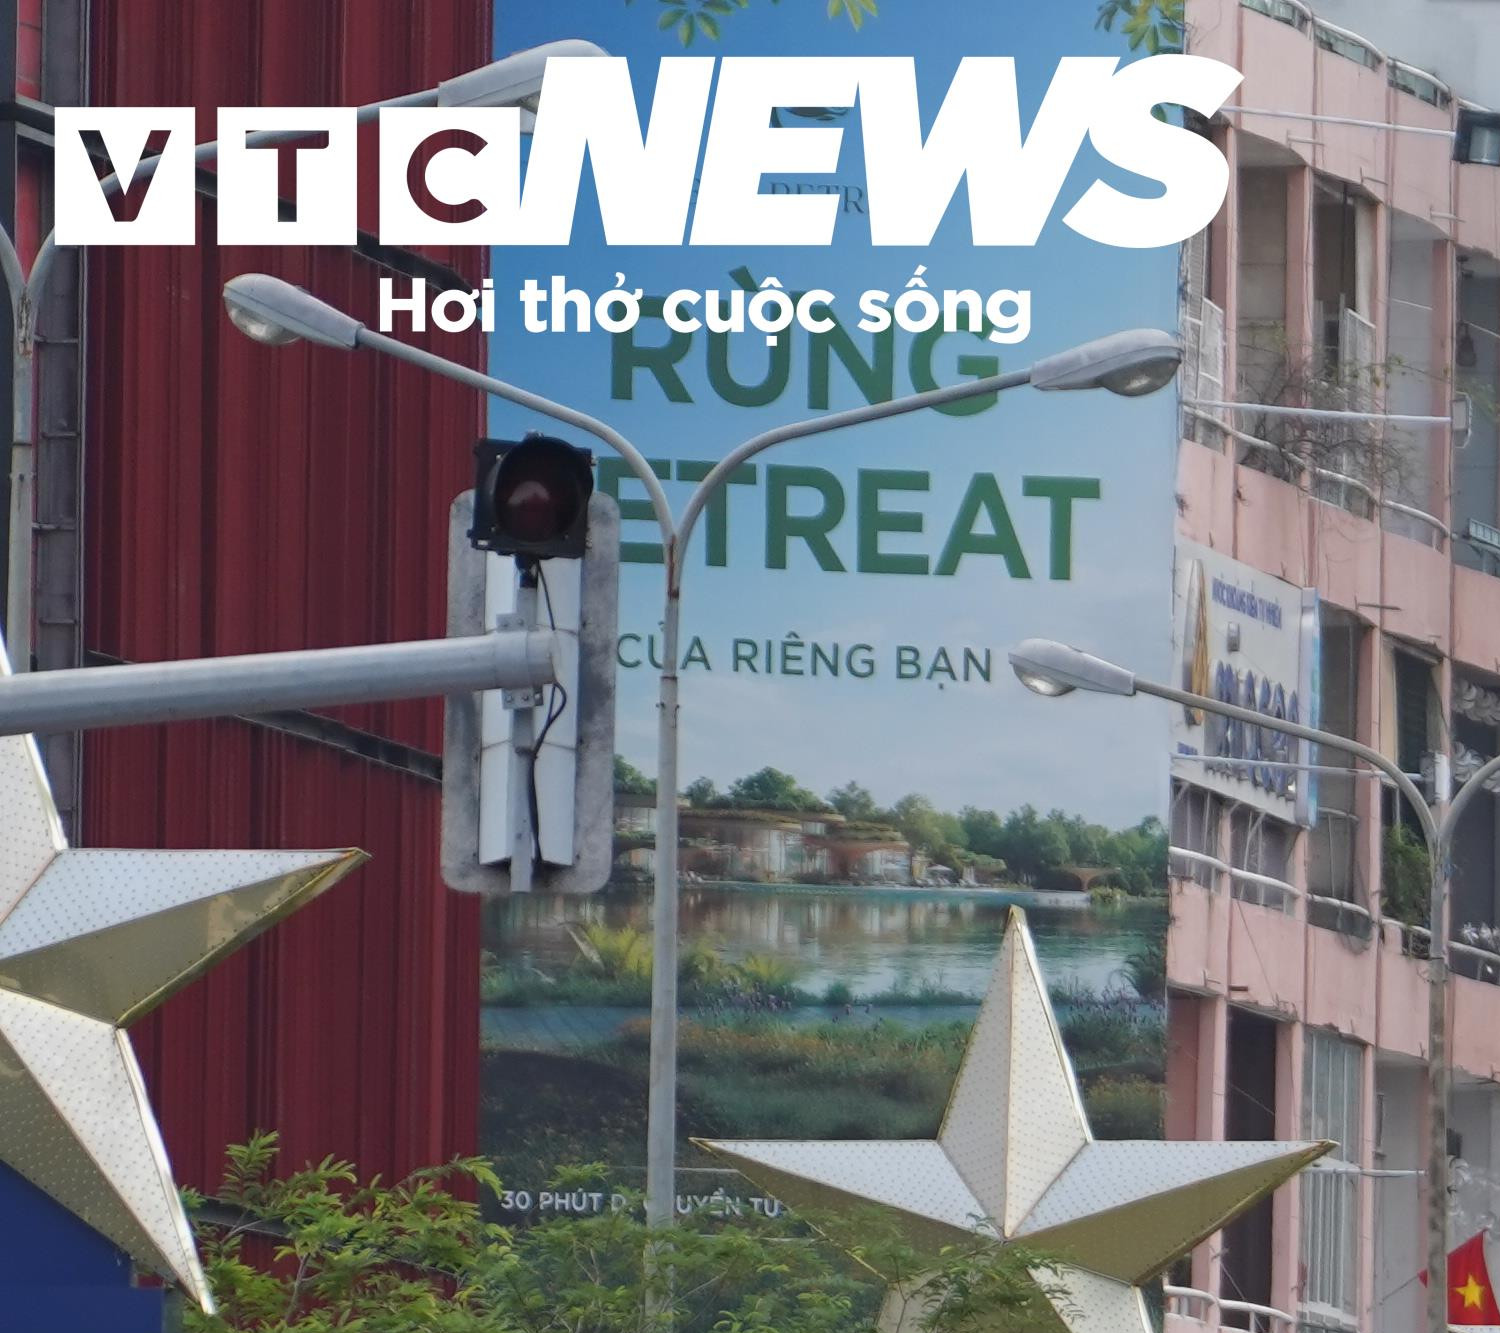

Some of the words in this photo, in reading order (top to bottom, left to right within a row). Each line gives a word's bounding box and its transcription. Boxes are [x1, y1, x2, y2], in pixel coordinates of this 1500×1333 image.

[597, 456, 1101, 581] ETREAT
[731, 630, 876, 679] RIÊNG
[895, 644, 992, 690] BẠN
[501, 1190, 531, 1212] 30
[539, 1183, 601, 1213] PHÚT
